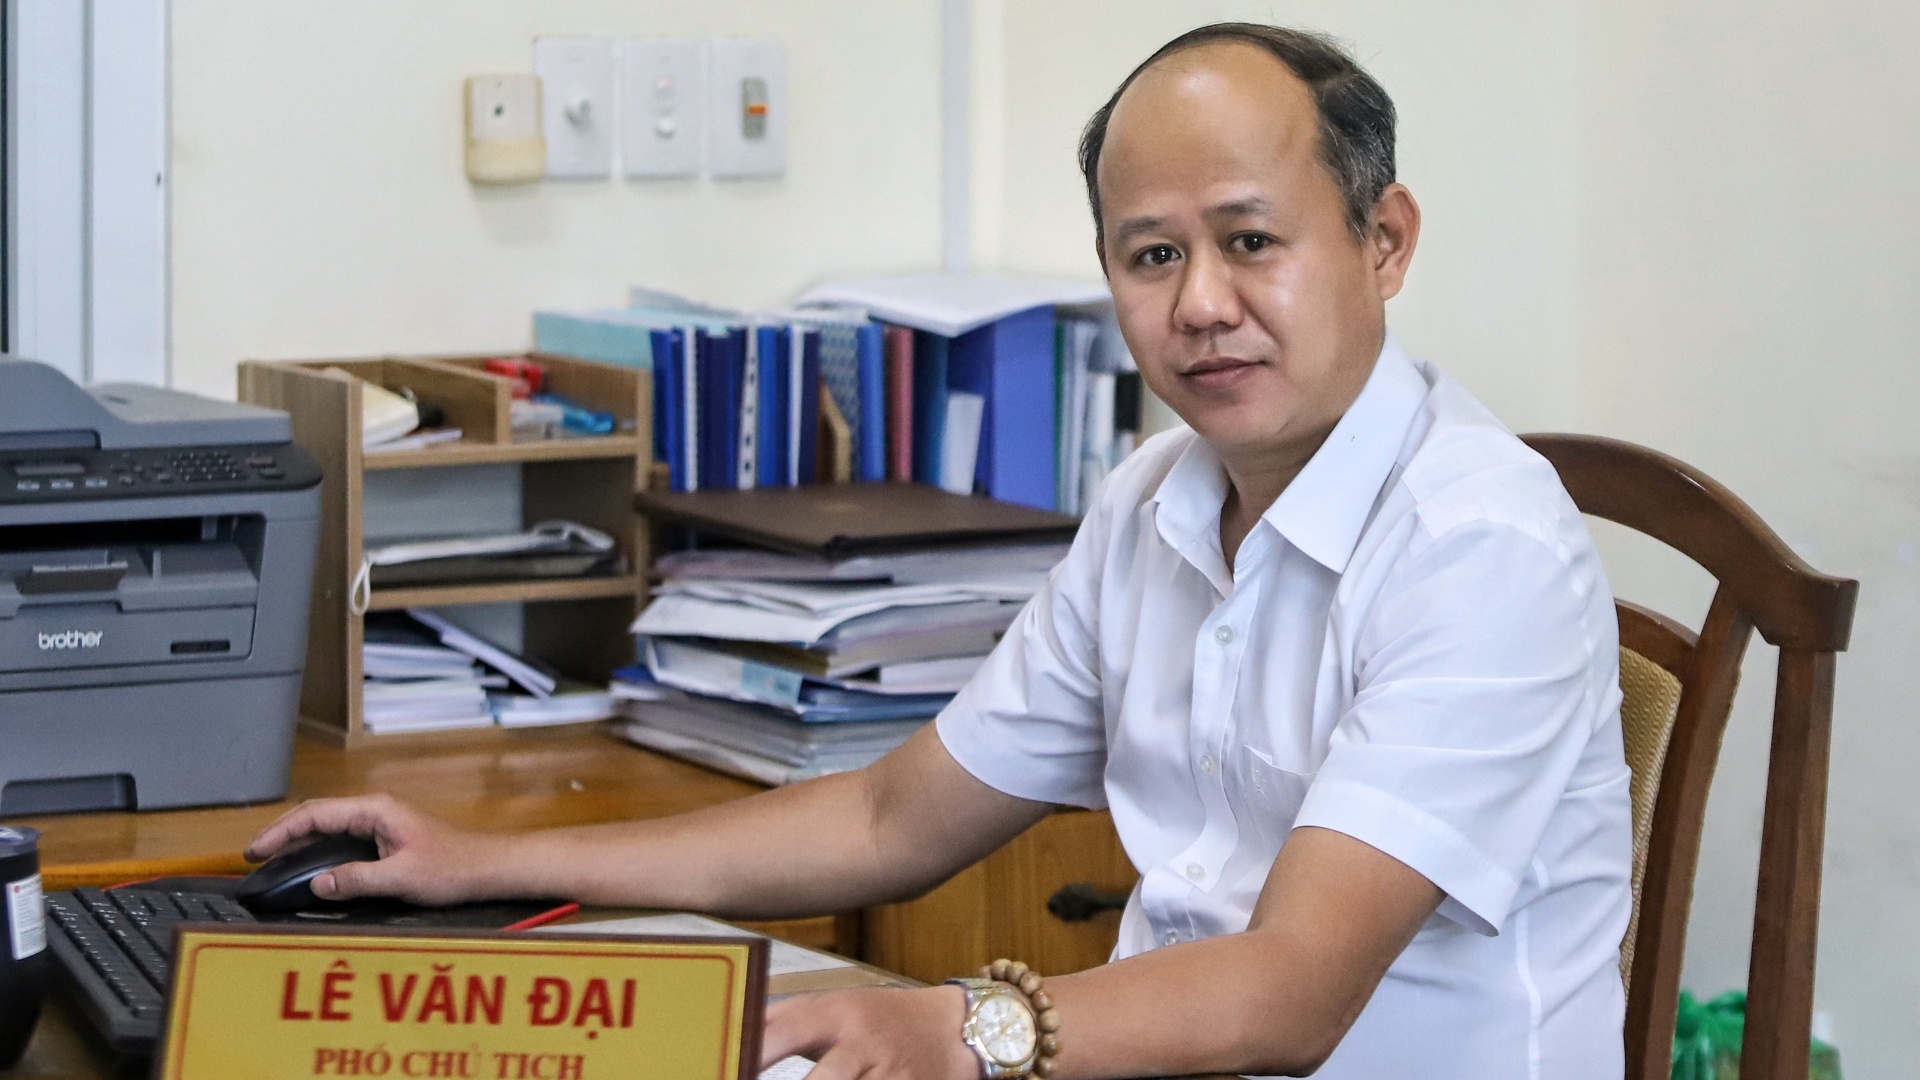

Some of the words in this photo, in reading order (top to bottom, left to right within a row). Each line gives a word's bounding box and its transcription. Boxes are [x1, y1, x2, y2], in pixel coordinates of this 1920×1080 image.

[38, 629, 103, 650] brother
[279, 959, 356, 1021] LÊ
[378, 963, 507, 1026] VĂN
[526, 975, 638, 1040] ĐẠI
[313, 1043, 393, 1078] PHÓ
[401, 1043, 483, 1079] CHỦ
